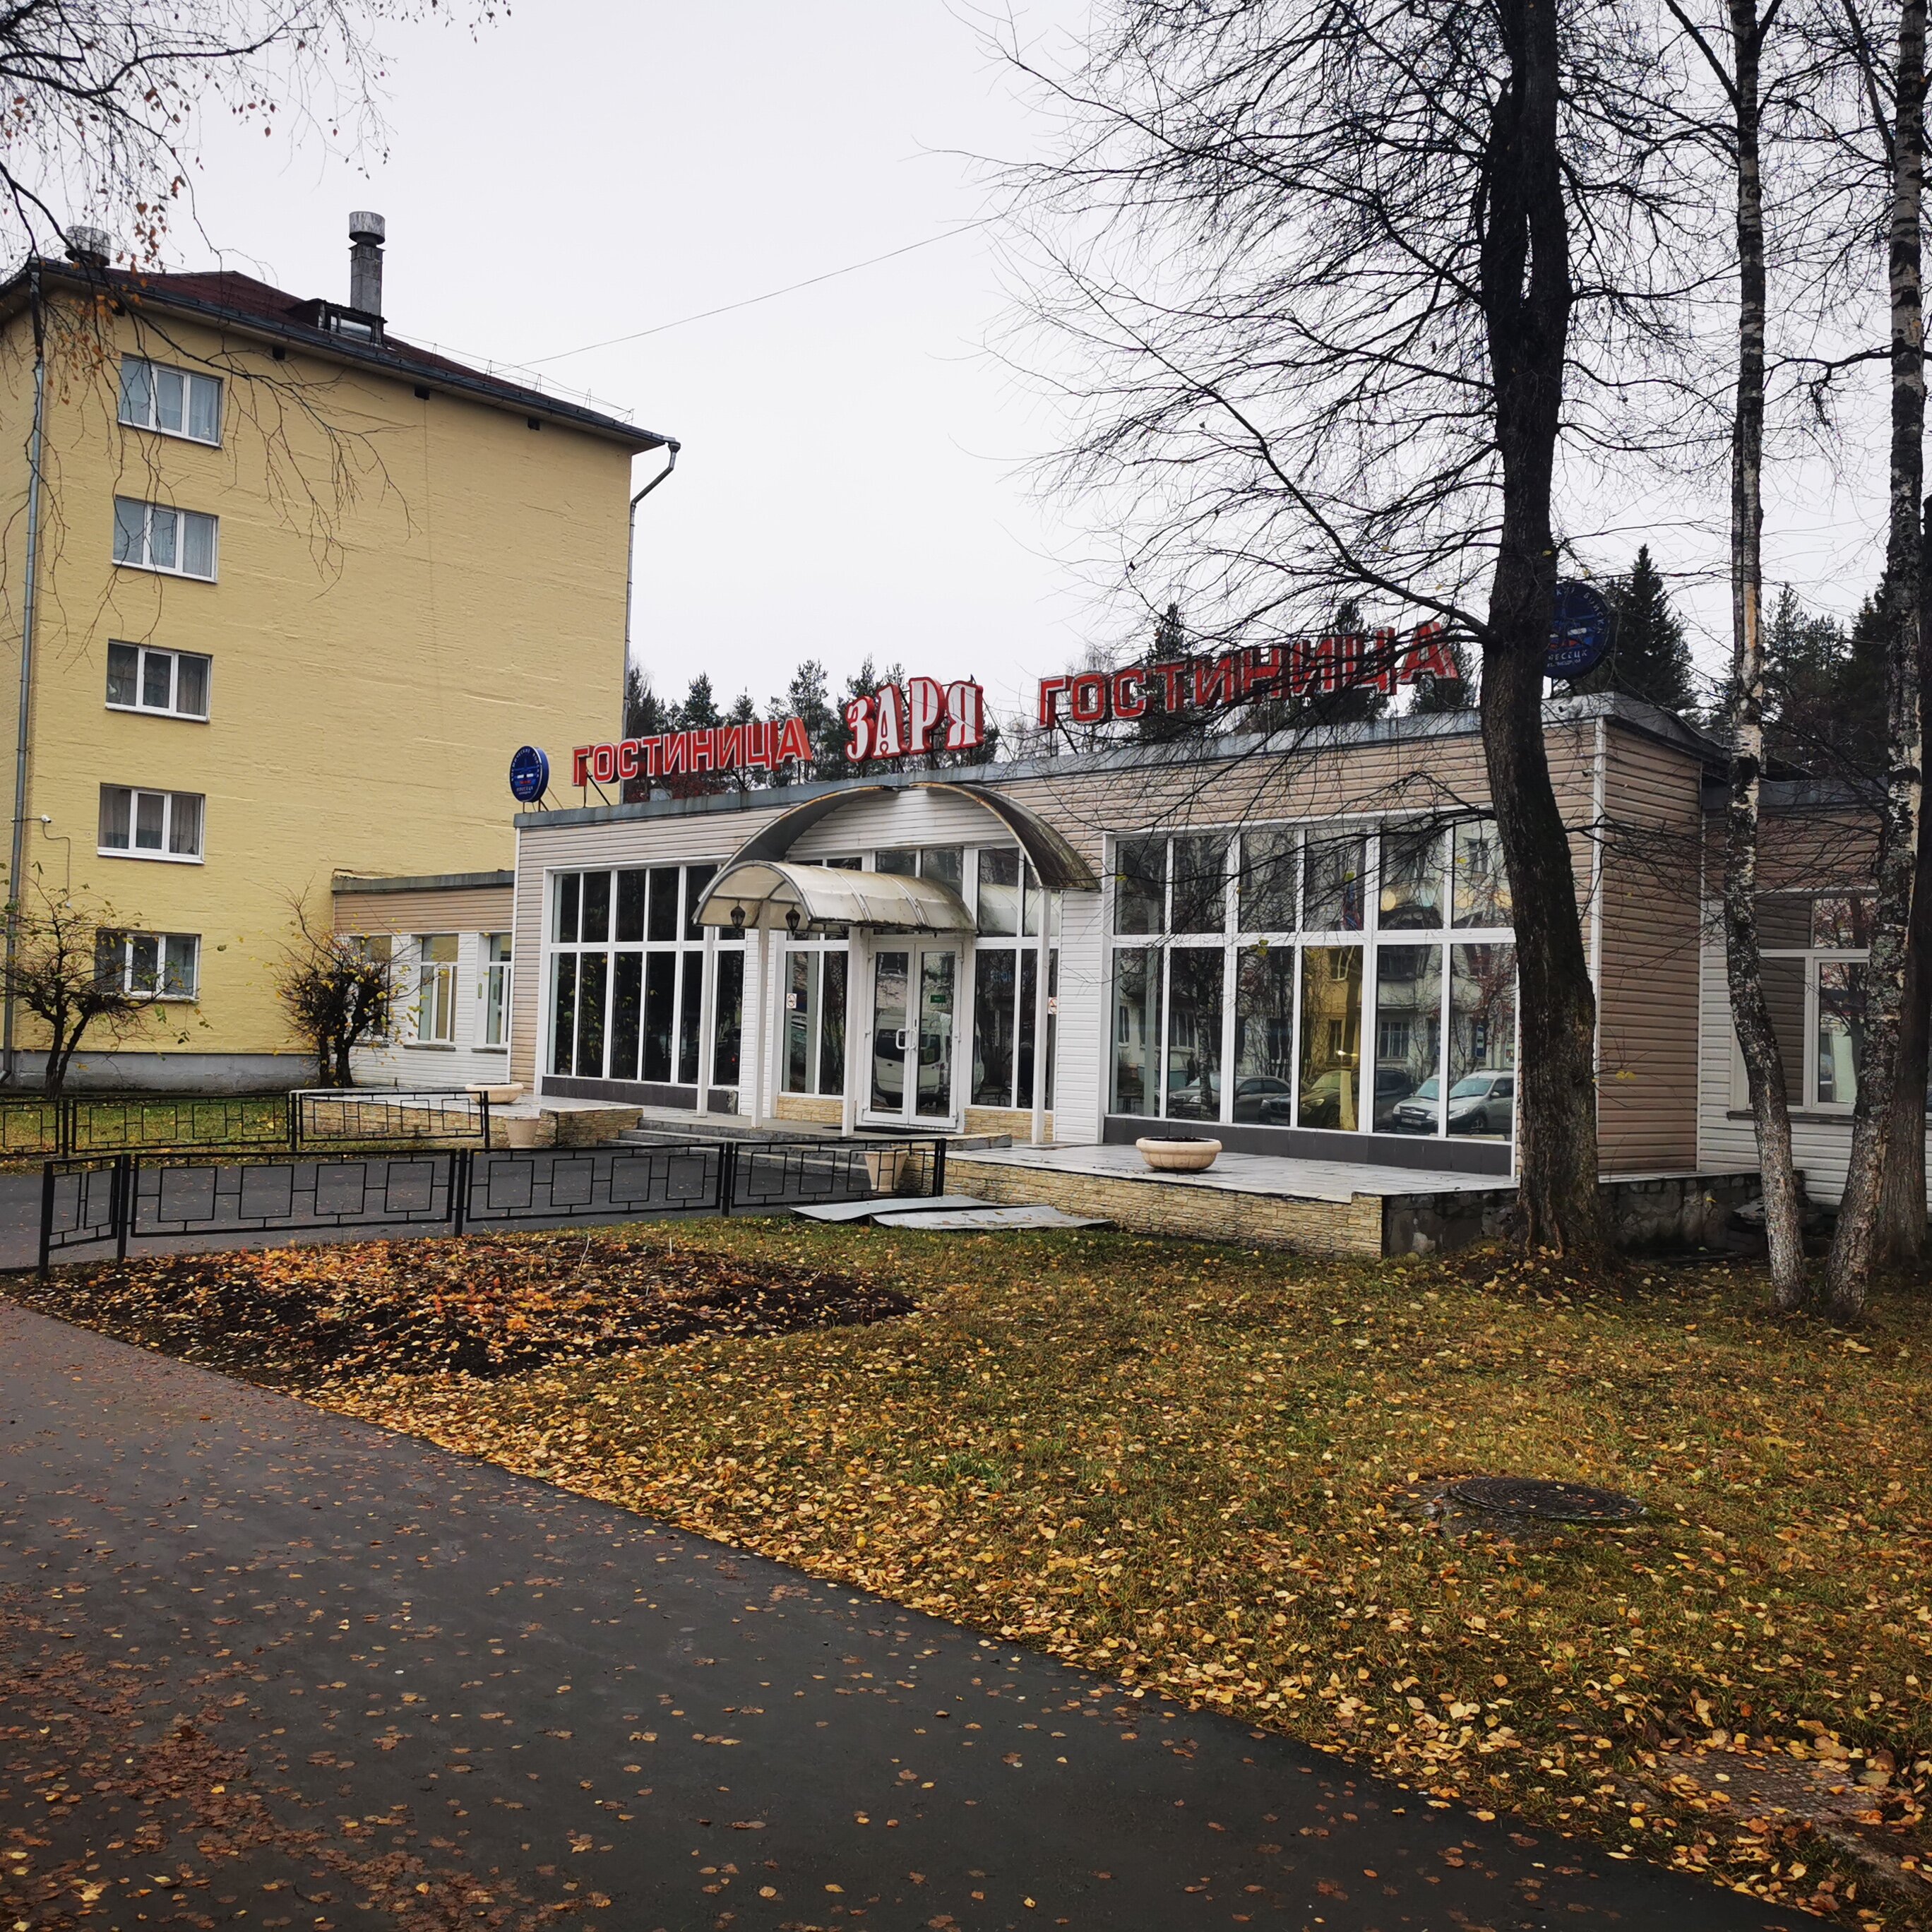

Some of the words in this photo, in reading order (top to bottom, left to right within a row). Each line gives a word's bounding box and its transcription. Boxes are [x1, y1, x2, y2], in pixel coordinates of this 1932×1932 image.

[1038, 621, 1459, 730] ГОСТИНИЦА
[572, 716, 812, 787] ГОСТИНИЦА
[847, 676, 984, 763] ЗАРЯ
